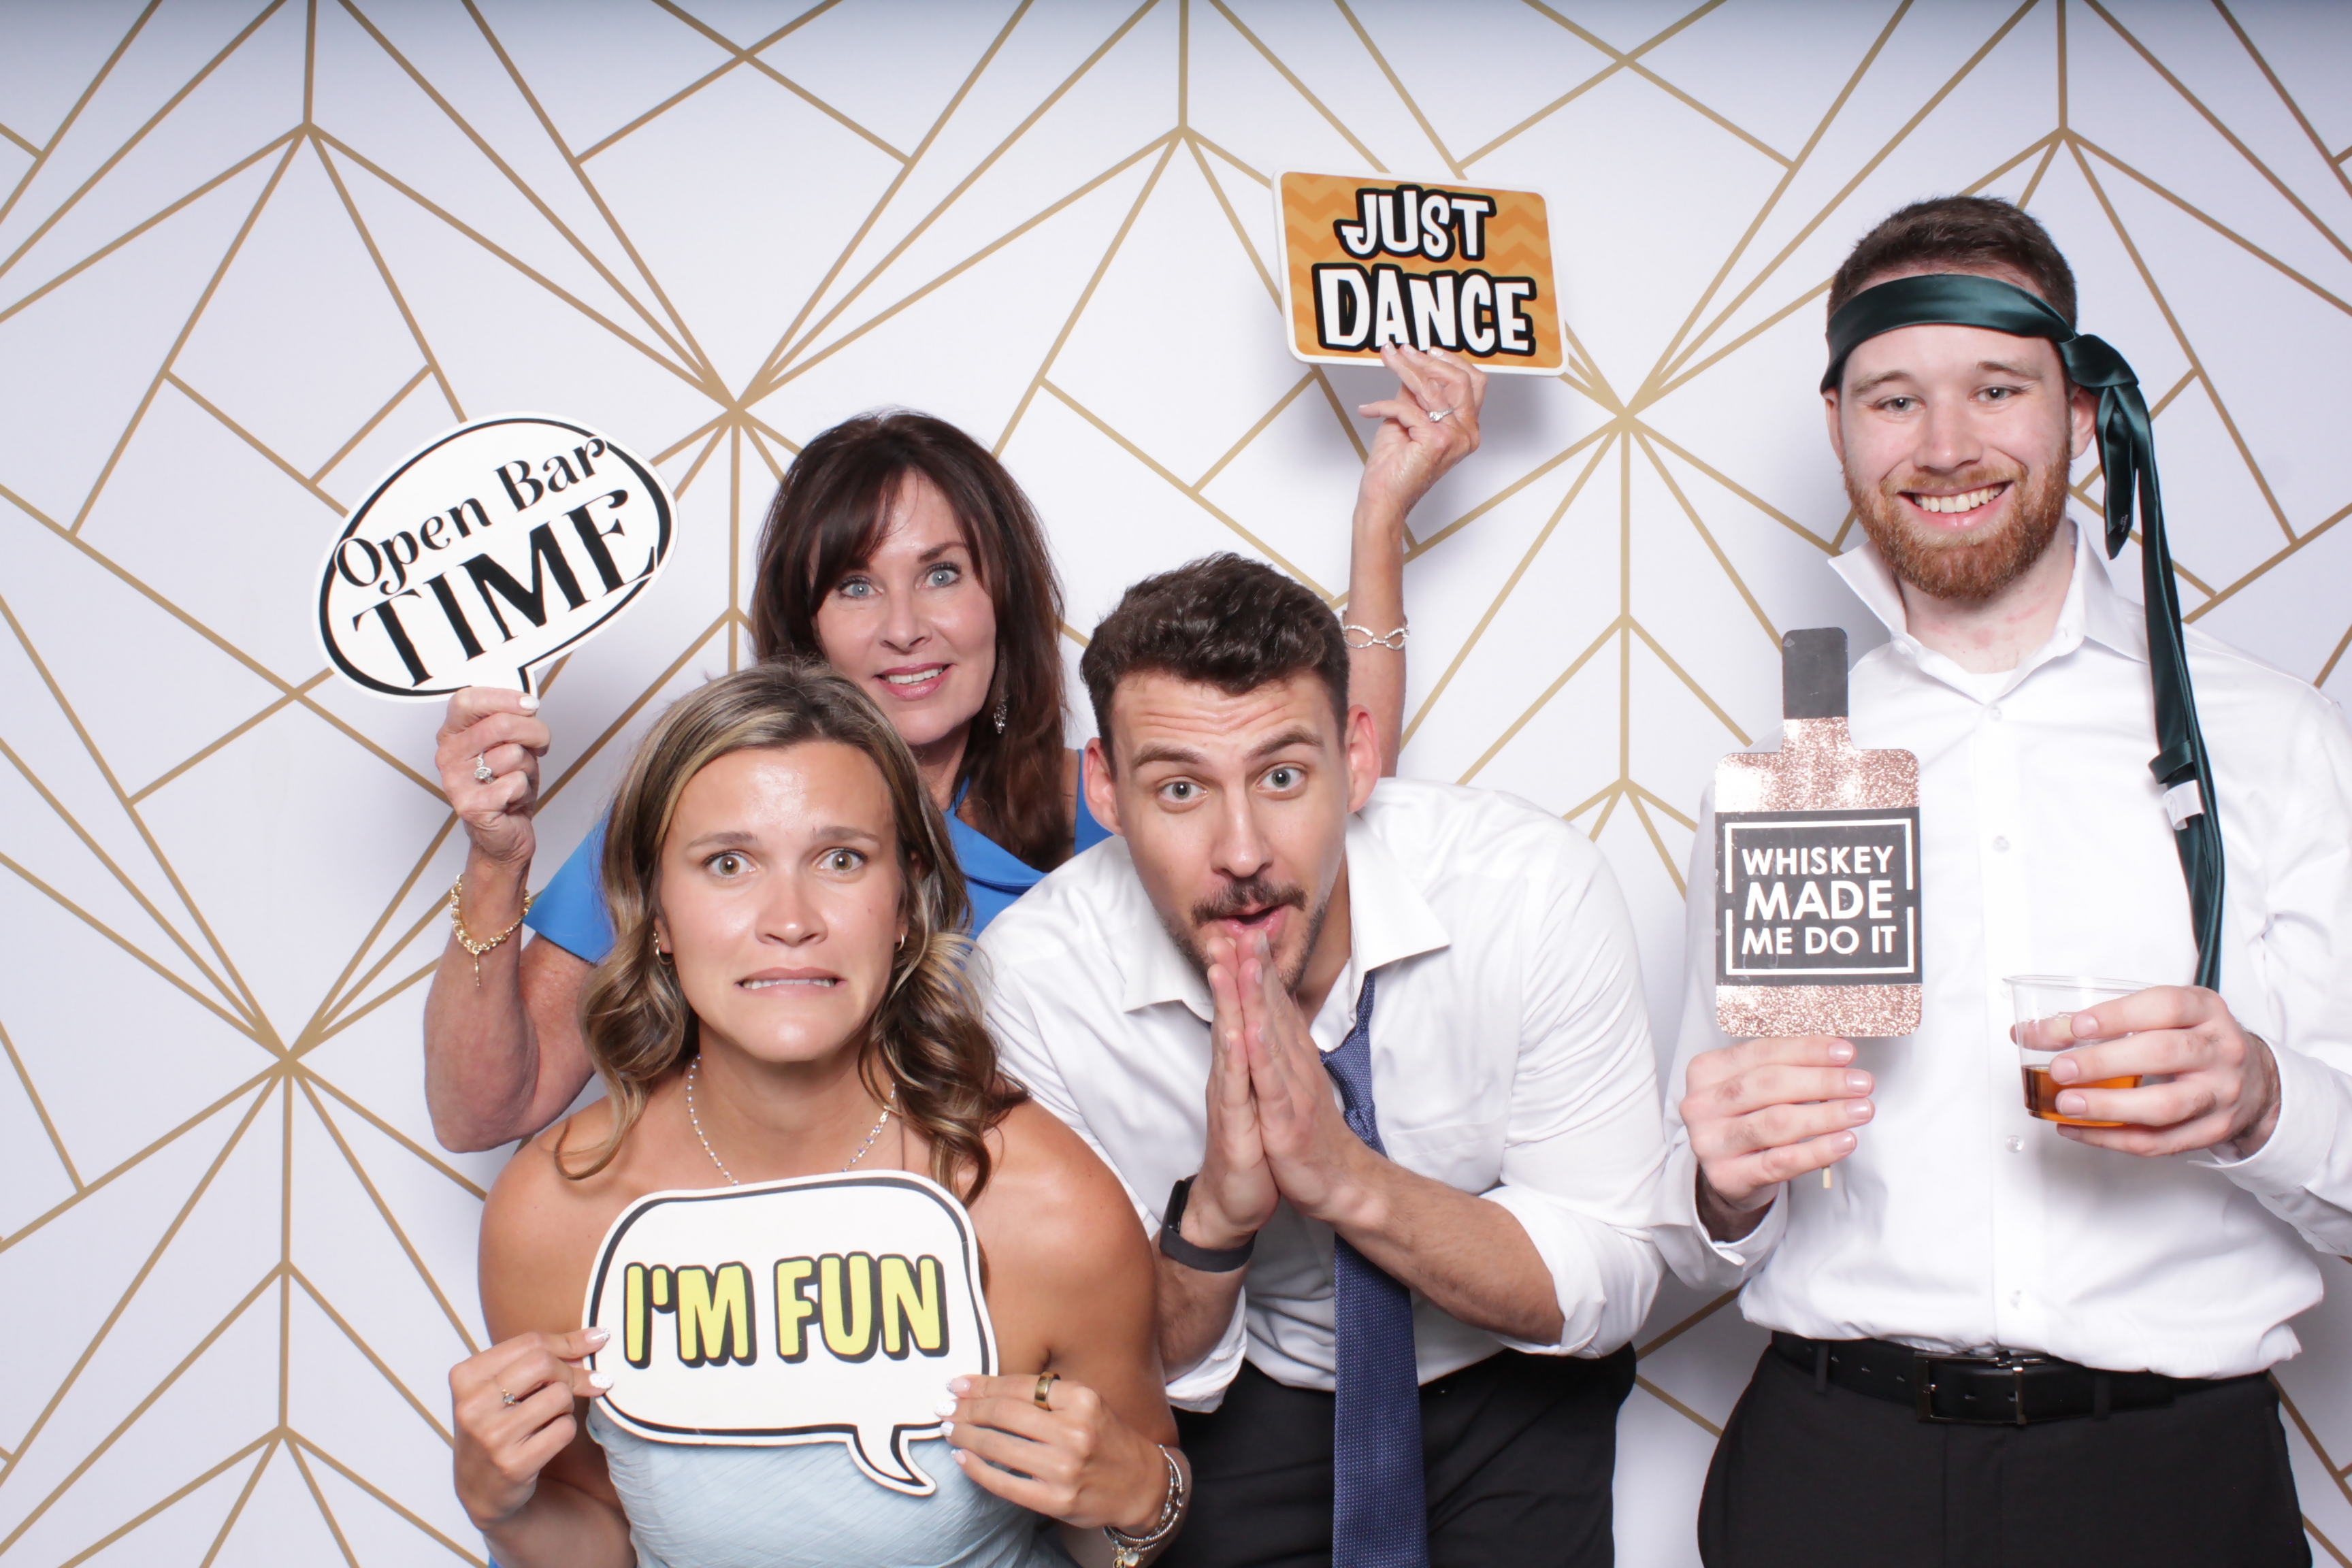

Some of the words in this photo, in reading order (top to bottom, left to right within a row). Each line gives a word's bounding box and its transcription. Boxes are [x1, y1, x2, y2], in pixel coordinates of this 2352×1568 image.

[1333, 184, 1497, 262] JUST
[1311, 263, 1537, 358] DANCE
[337, 497, 492, 595] Open
[493, 437, 606, 513] Bar
[353, 489, 655, 687] TIME
[1742, 846, 1893, 876] WHISKEY
[1744, 880, 1893, 921] MADE
[1742, 928, 1793, 955] ME
[1805, 926, 1860, 954] DO
[1872, 926, 1897, 953] IT
[624, 1260, 757, 1369] I'M
[774, 1251, 949, 1363] FUN
